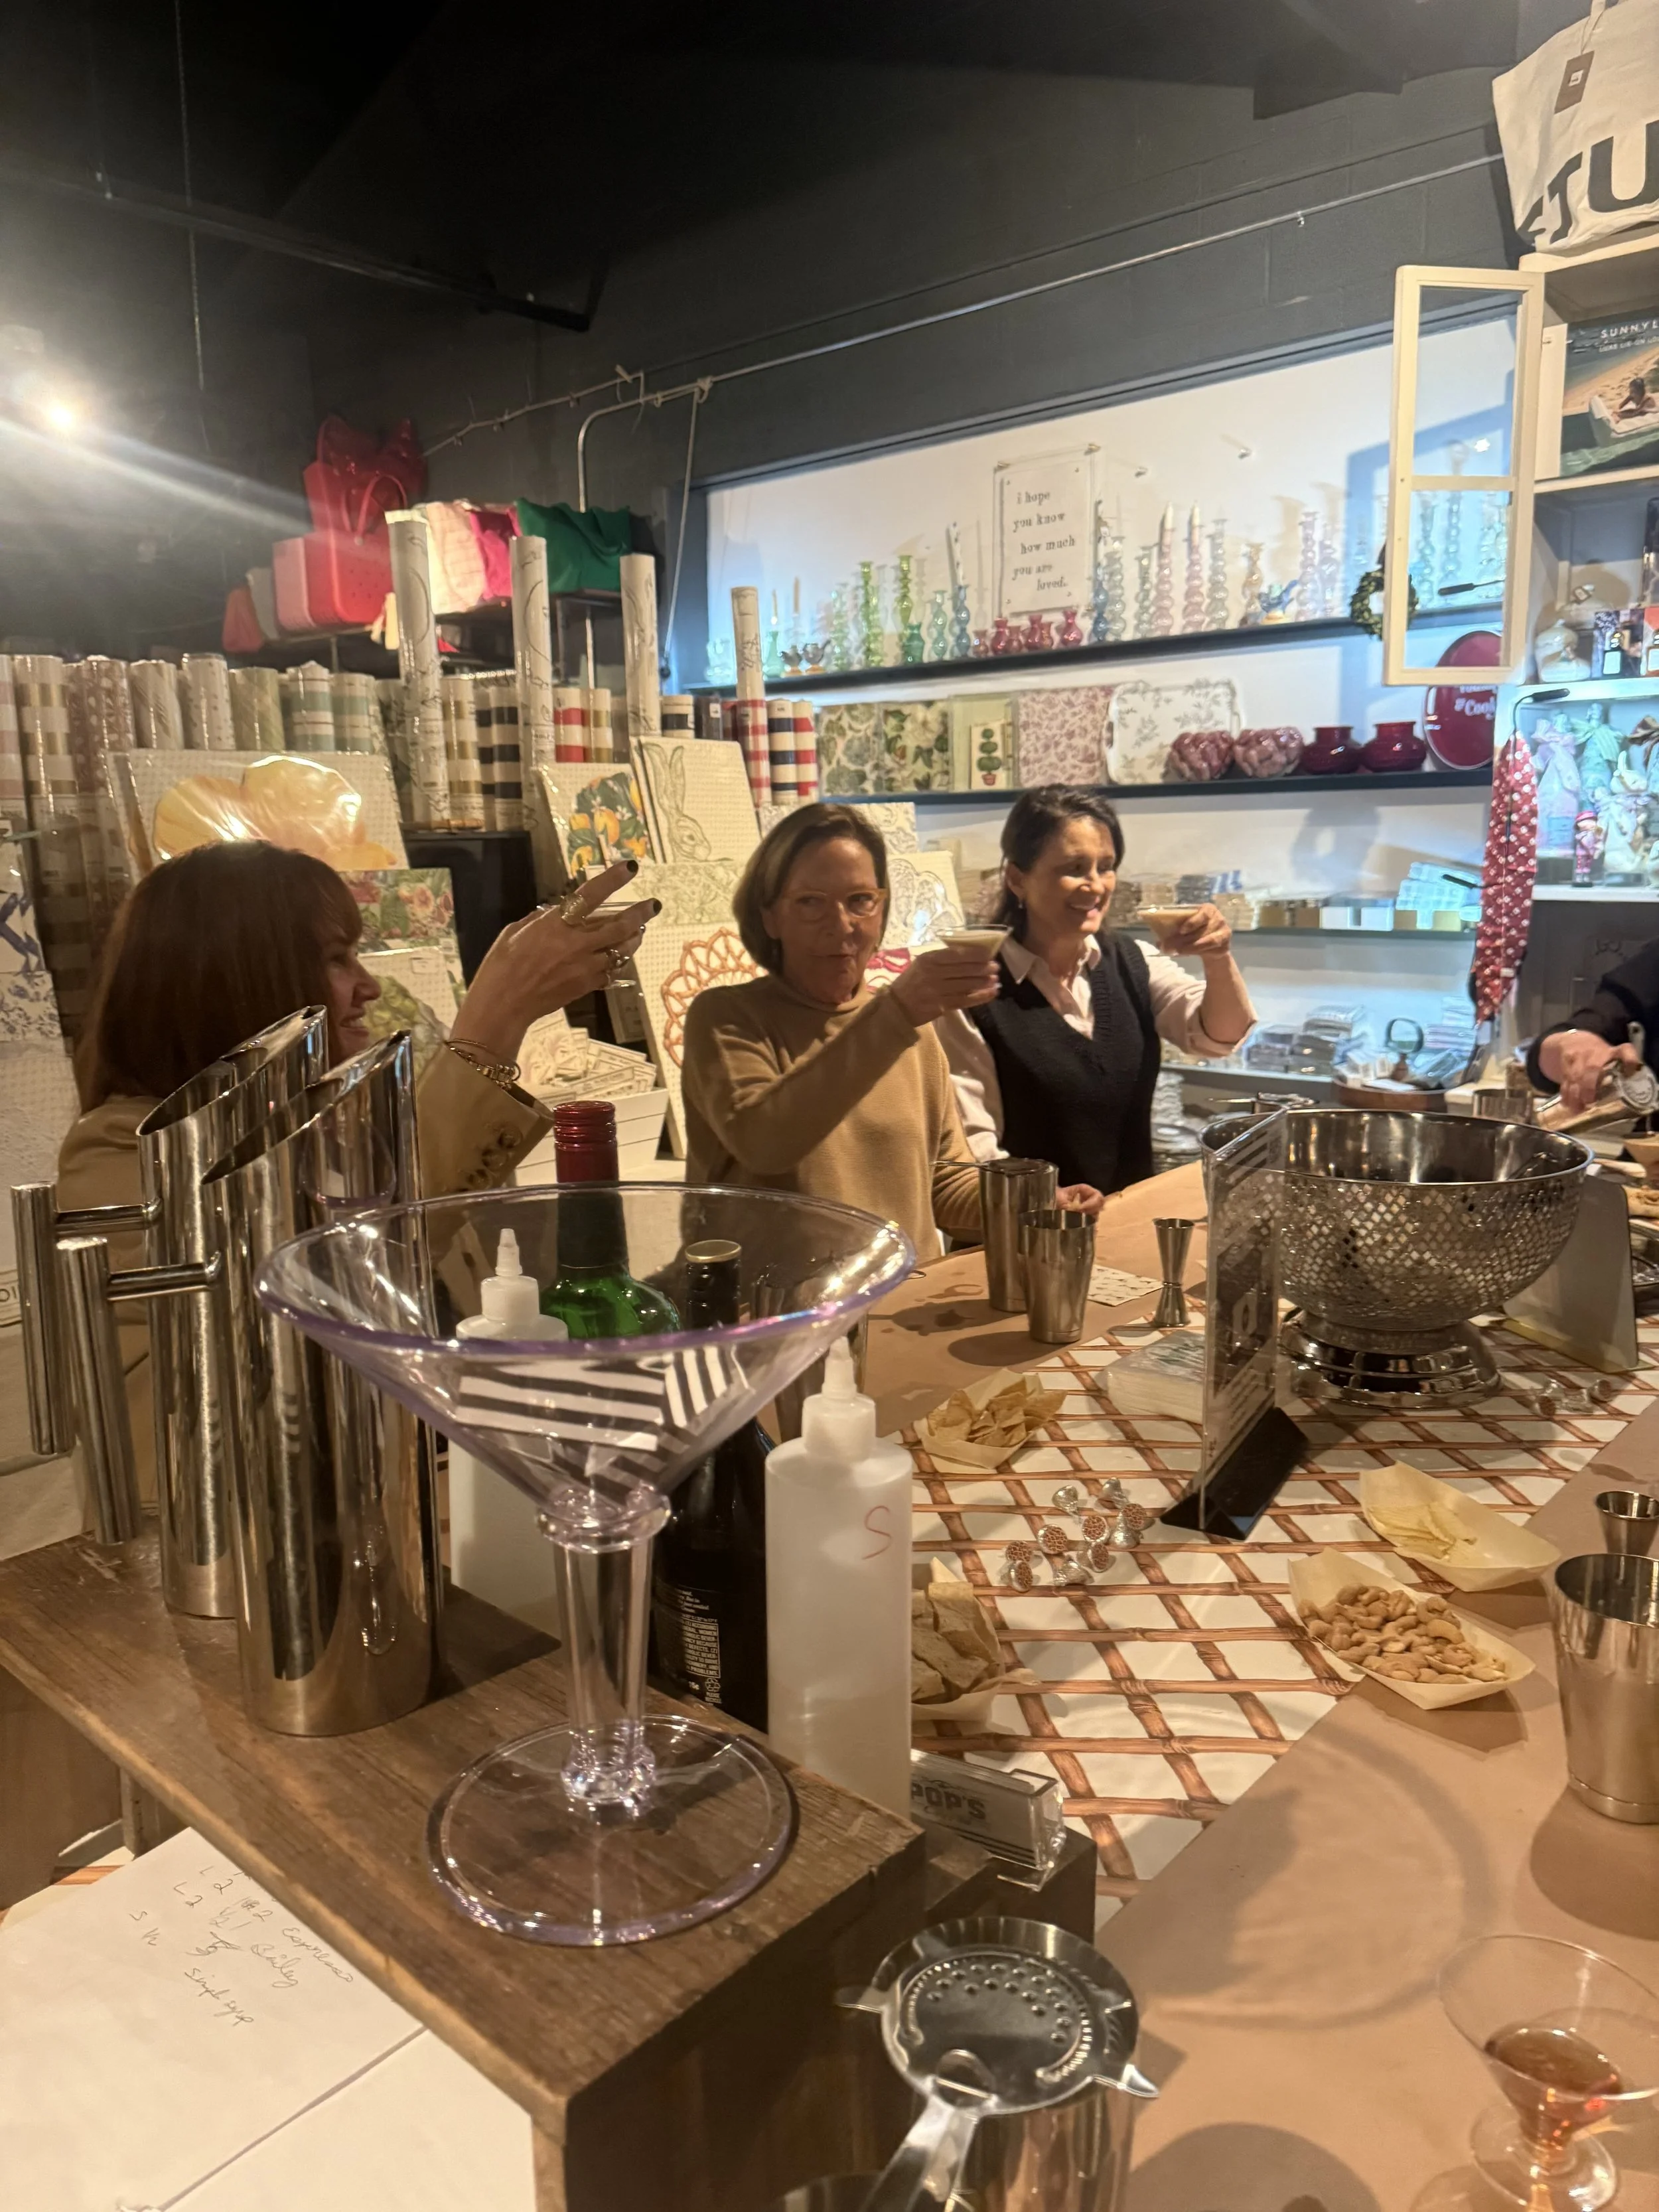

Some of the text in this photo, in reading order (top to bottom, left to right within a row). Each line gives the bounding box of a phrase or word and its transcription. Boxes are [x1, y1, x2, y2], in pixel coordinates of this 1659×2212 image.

[1017, 491, 1050, 506] i hope
[1013, 513, 1065, 533] you know
[1021, 534, 1075, 555] how much
[1012, 564, 1053, 581] you are
[1037, 576, 1068, 591] loved.
[861, 1505, 893, 1560] S
